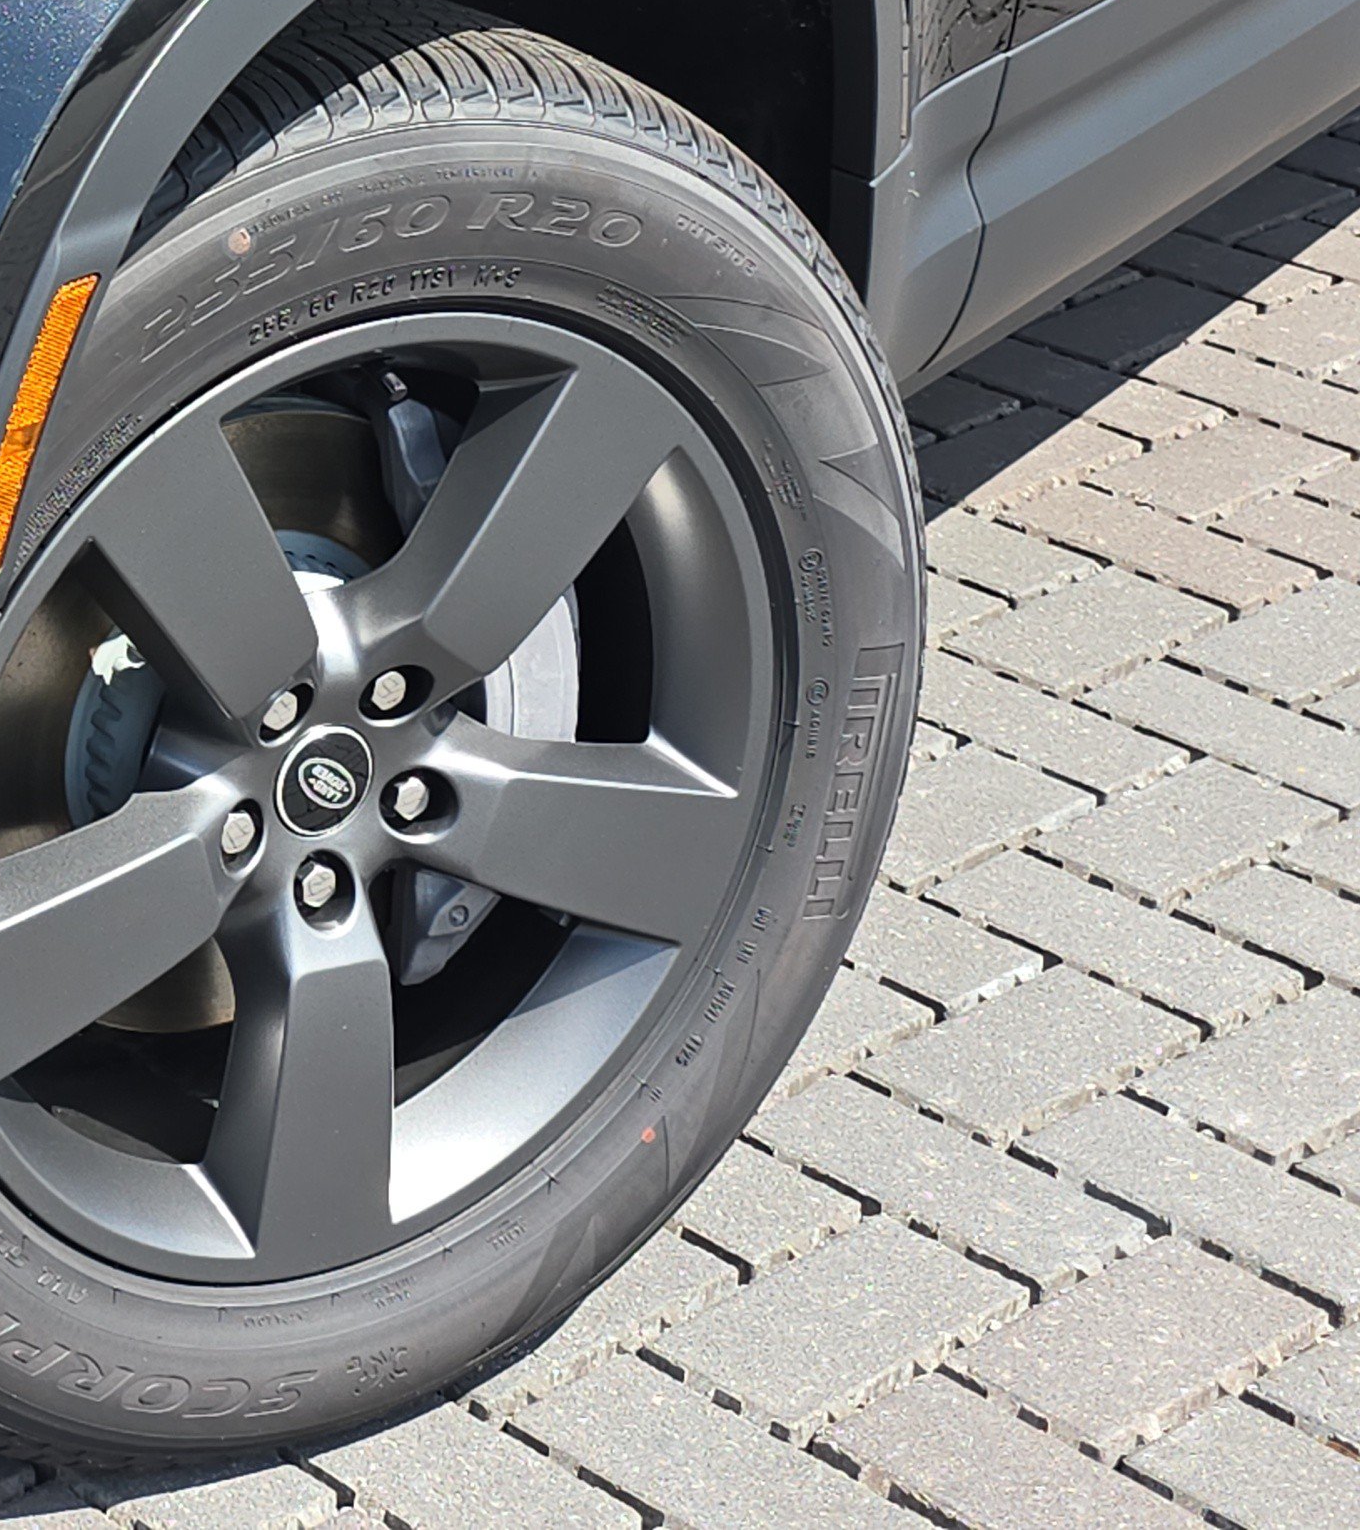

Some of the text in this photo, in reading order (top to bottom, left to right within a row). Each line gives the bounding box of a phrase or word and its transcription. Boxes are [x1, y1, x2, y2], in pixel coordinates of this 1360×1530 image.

[466, 191, 645, 249] R20
[800, 642, 906, 921] PIRELLI
[36, 1265, 90, 1305] ALL
